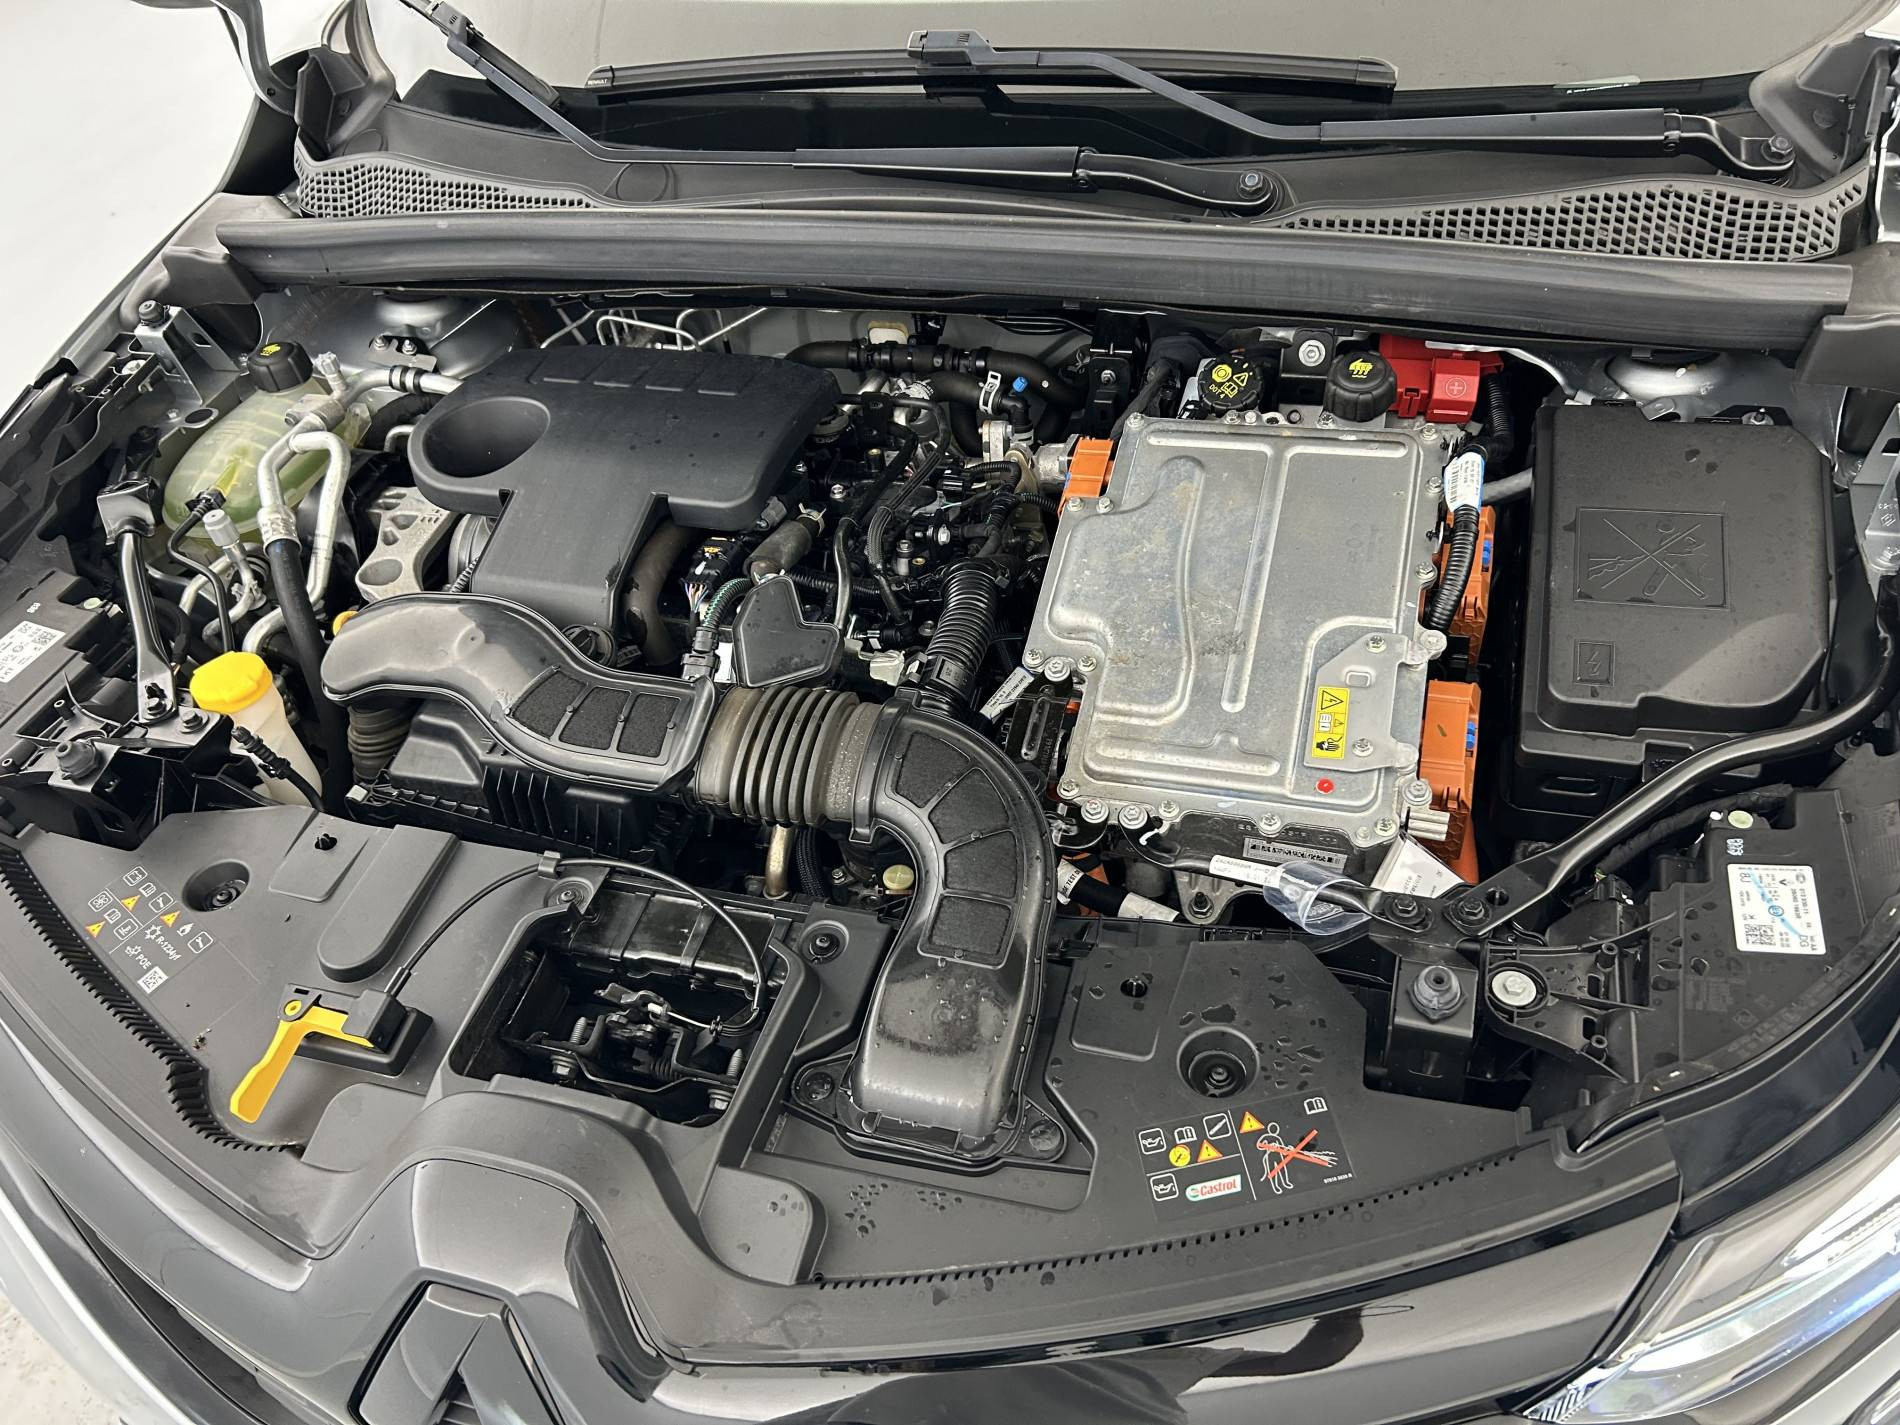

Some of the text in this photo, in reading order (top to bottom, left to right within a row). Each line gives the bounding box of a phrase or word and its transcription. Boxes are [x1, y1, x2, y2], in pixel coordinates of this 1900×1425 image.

[1209, 384, 1222, 395] DOT
[156, 935, 181, 961] R-1234yf
[135, 954, 151, 970] POE
[1200, 1179, 1237, 1197] Castrol
